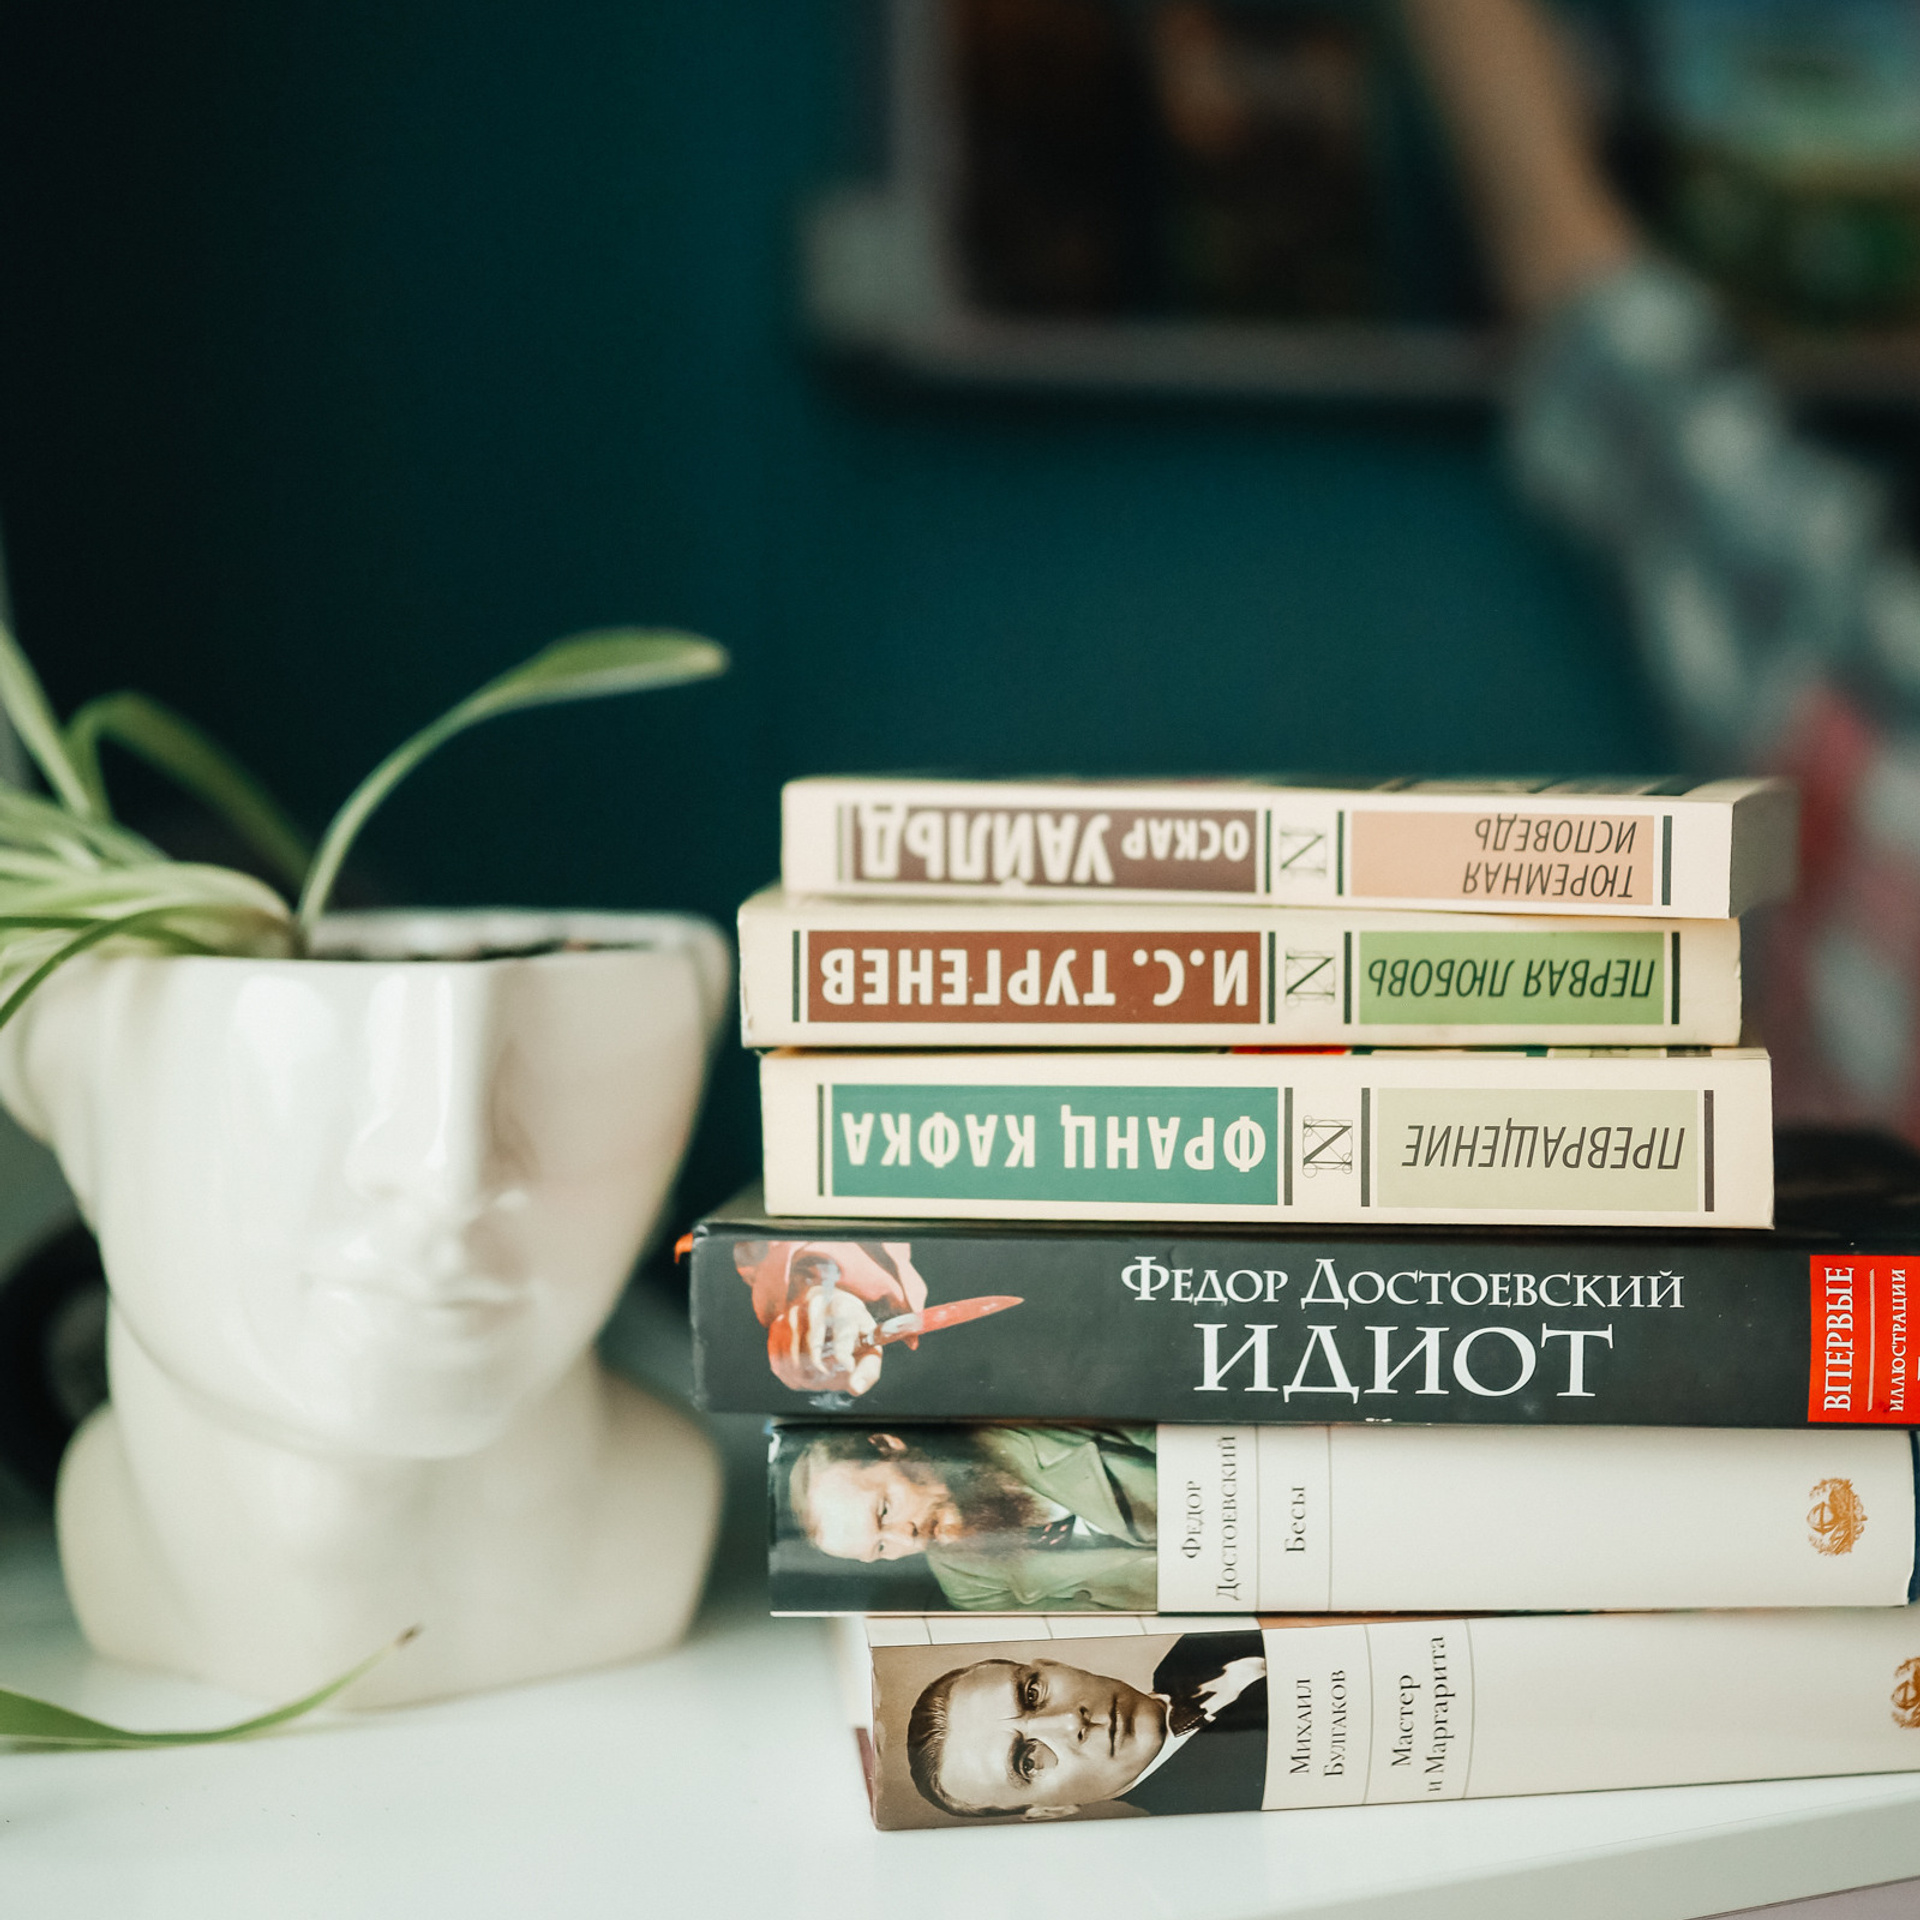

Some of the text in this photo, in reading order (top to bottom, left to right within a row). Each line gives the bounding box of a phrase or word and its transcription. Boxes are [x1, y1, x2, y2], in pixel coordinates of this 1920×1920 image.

[858, 803, 1250, 889] ОСКАР УАЙЛЬД
[1473, 814, 1638, 855] ИСПОВЕДЬ
[1461, 861, 1634, 899] ТЮРЕМНАЯ
[819, 948, 1249, 1007] И.С. ТУРГЕНЕВ
[1366, 958, 1656, 999] ПЕРВАЯ ЛЮБОВЬ
[841, 1104, 1267, 1173] ФРАНЦ КАФКА
[1401, 1117, 1686, 1171] ПРЕВРАЩЕНИЕ
[1193, 1323, 1615, 1404] ИДИОТ
[1823, 1267, 1856, 1412] ВПЕРВЫЕ
[1889, 1268, 1908, 1412] ИЛЛЮСТРАЦИИ
[1285, 1486, 1307, 1553] Бесы
[1391, 1674, 1421, 1768] Мастер
[1424, 1634, 1456, 1792] и Маргарита
